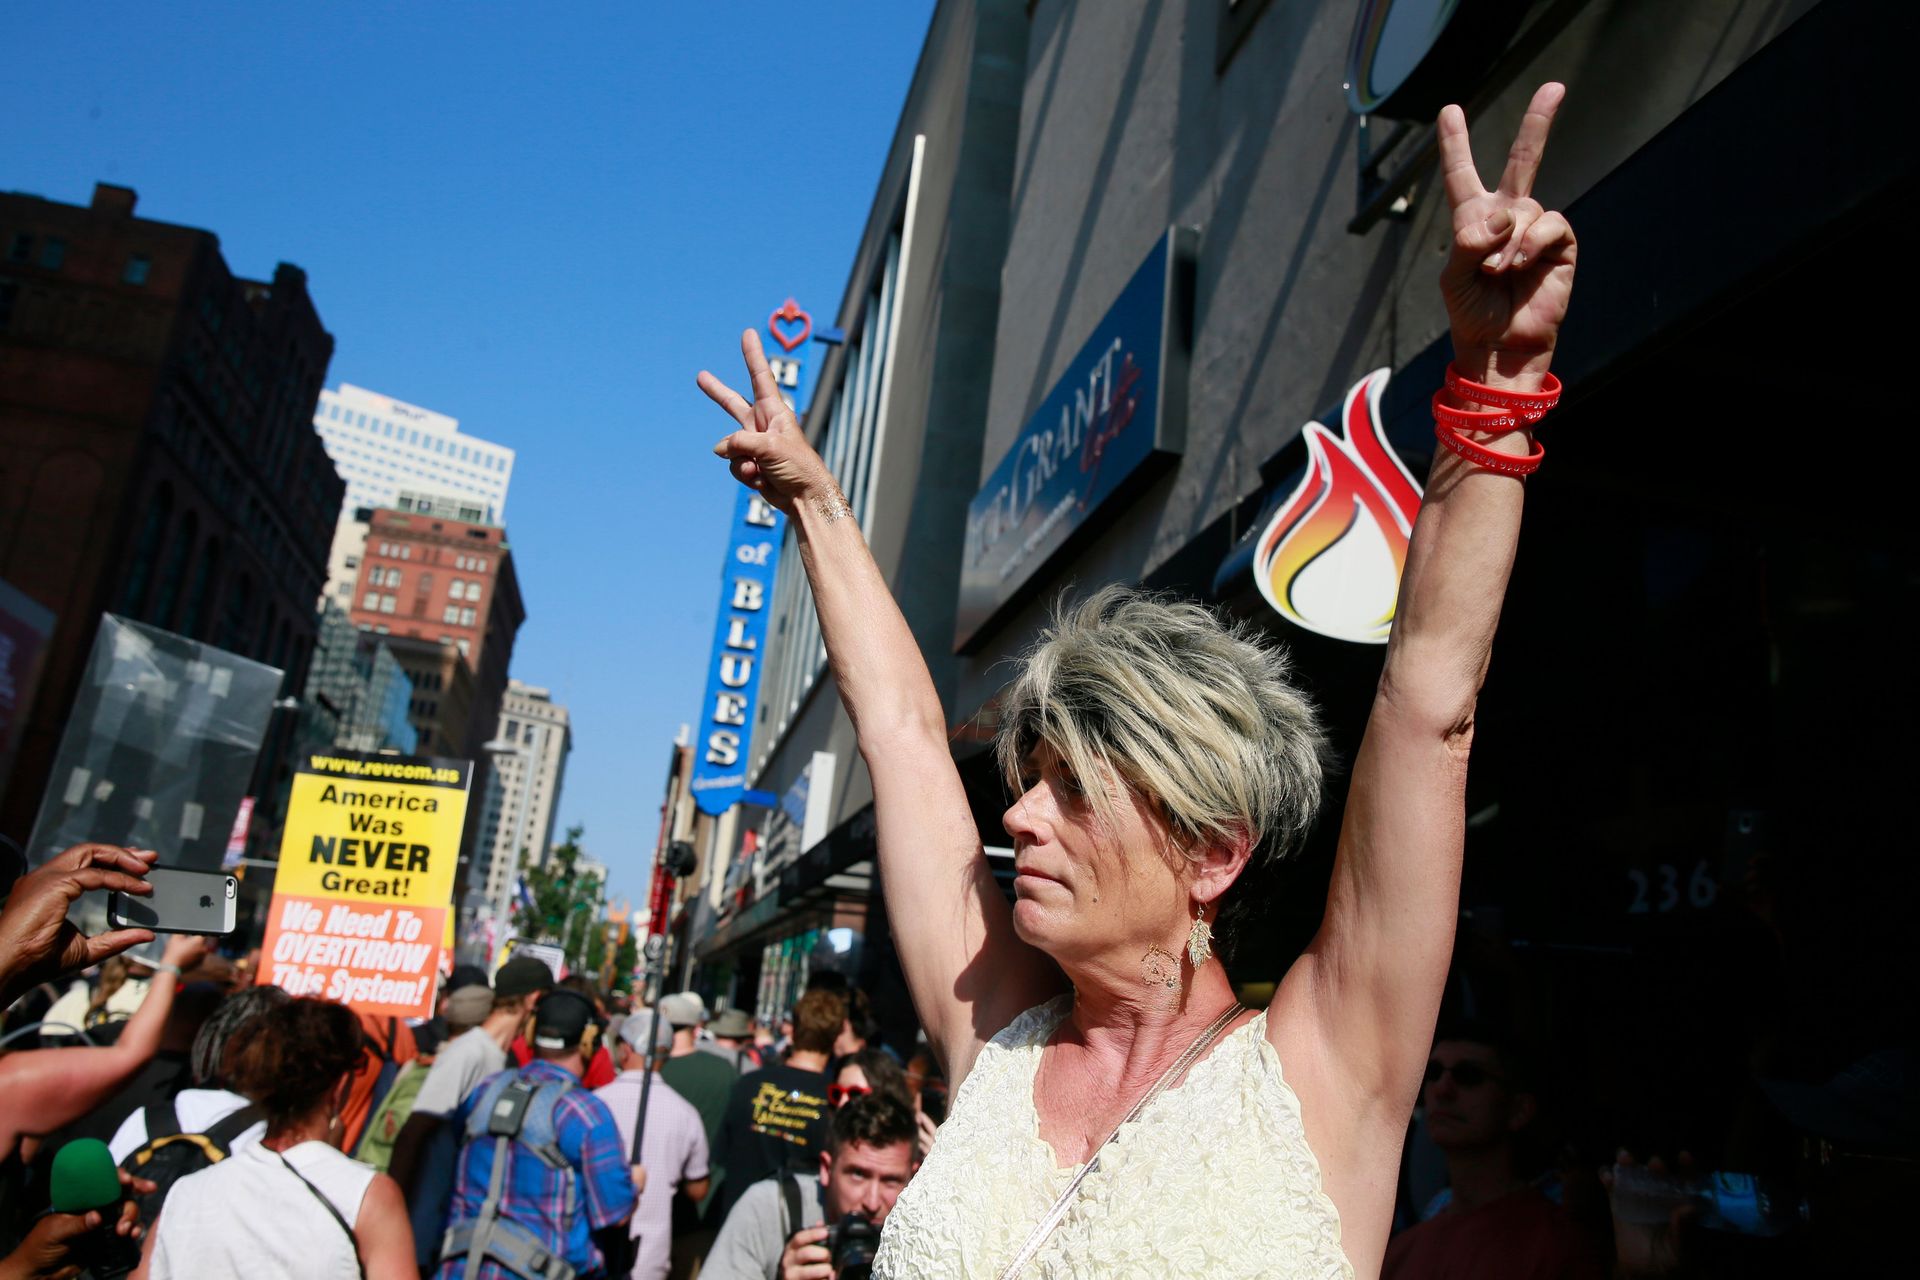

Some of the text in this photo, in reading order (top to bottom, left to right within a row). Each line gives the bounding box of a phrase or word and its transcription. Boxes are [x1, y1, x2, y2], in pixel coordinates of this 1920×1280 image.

[1459, 385, 1509, 406] America
[1009, 337, 1121, 527] GRANT
[1480, 415, 1516, 427] Again
[736, 542, 773, 567] of
[705, 578, 764, 766] BLUES
[311, 755, 460, 783] www.revcom.us
[320, 784, 438, 813] America
[349, 813, 404, 835] Was
[308, 835, 431, 873] NEVER
[321, 871, 411, 898] Great!
[1627, 860, 1717, 914] 236
[280, 900, 423, 942] We Need To
[271, 931, 432, 974] OVERTHROW
[271, 963, 430, 1006] This System!
